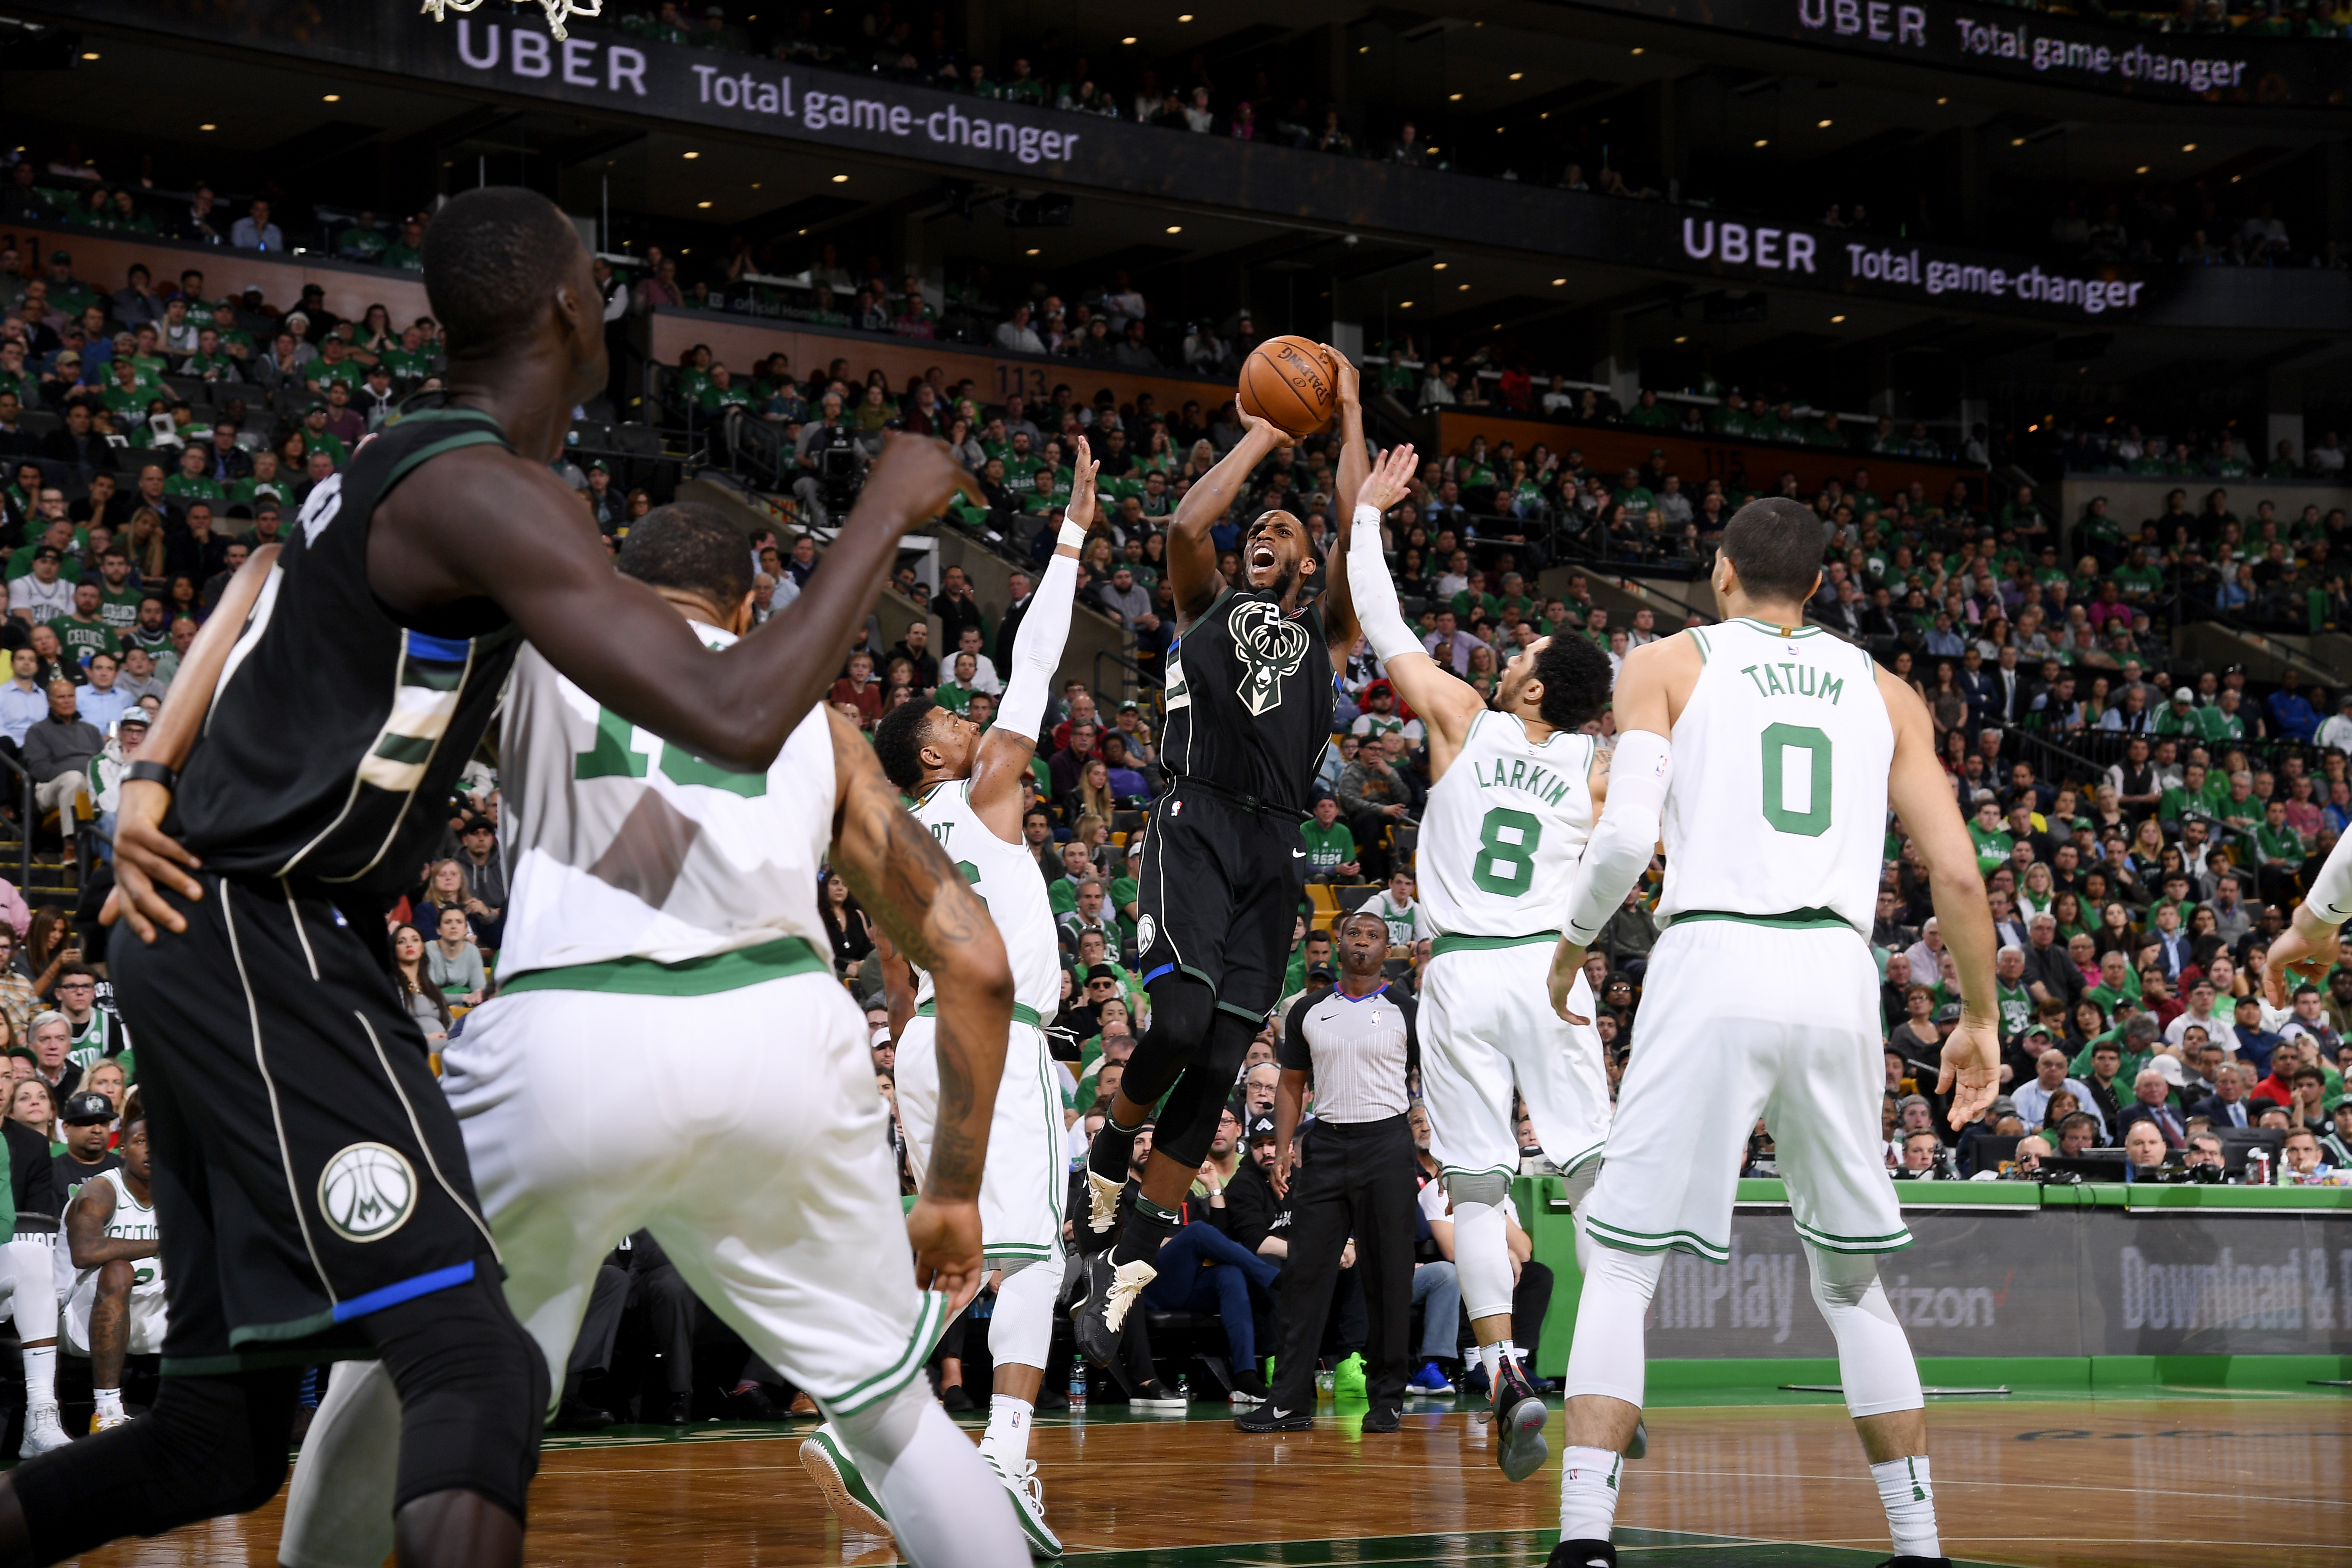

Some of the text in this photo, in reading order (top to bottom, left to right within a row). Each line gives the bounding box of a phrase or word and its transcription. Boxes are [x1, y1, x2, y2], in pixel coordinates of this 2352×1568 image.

[1799, 0, 1927, 47] UBER
[457, 18, 648, 96] UBER
[1955, 18, 2246, 93] Total game-changer
[691, 63, 1079, 164] Total game-changer
[1682, 217, 1817, 275] UBER
[1846, 244, 2144, 315] Total game-changer
[997, 365, 1045, 396] 113
[1277, 345, 1331, 406] SPALDING
[1703, 448, 1744, 476] 115
[67, 629, 105, 649] CELTICS
[1741, 662, 1844, 706] TATUM
[1474, 758, 1571, 807] LARKIN
[1761, 722, 1832, 837] 0
[1473, 806, 1542, 898] 8
[1890, 1274, 1995, 1327] izon
[2121, 1245, 2303, 1330] Download
[2308, 1247, 2335, 1330] &
